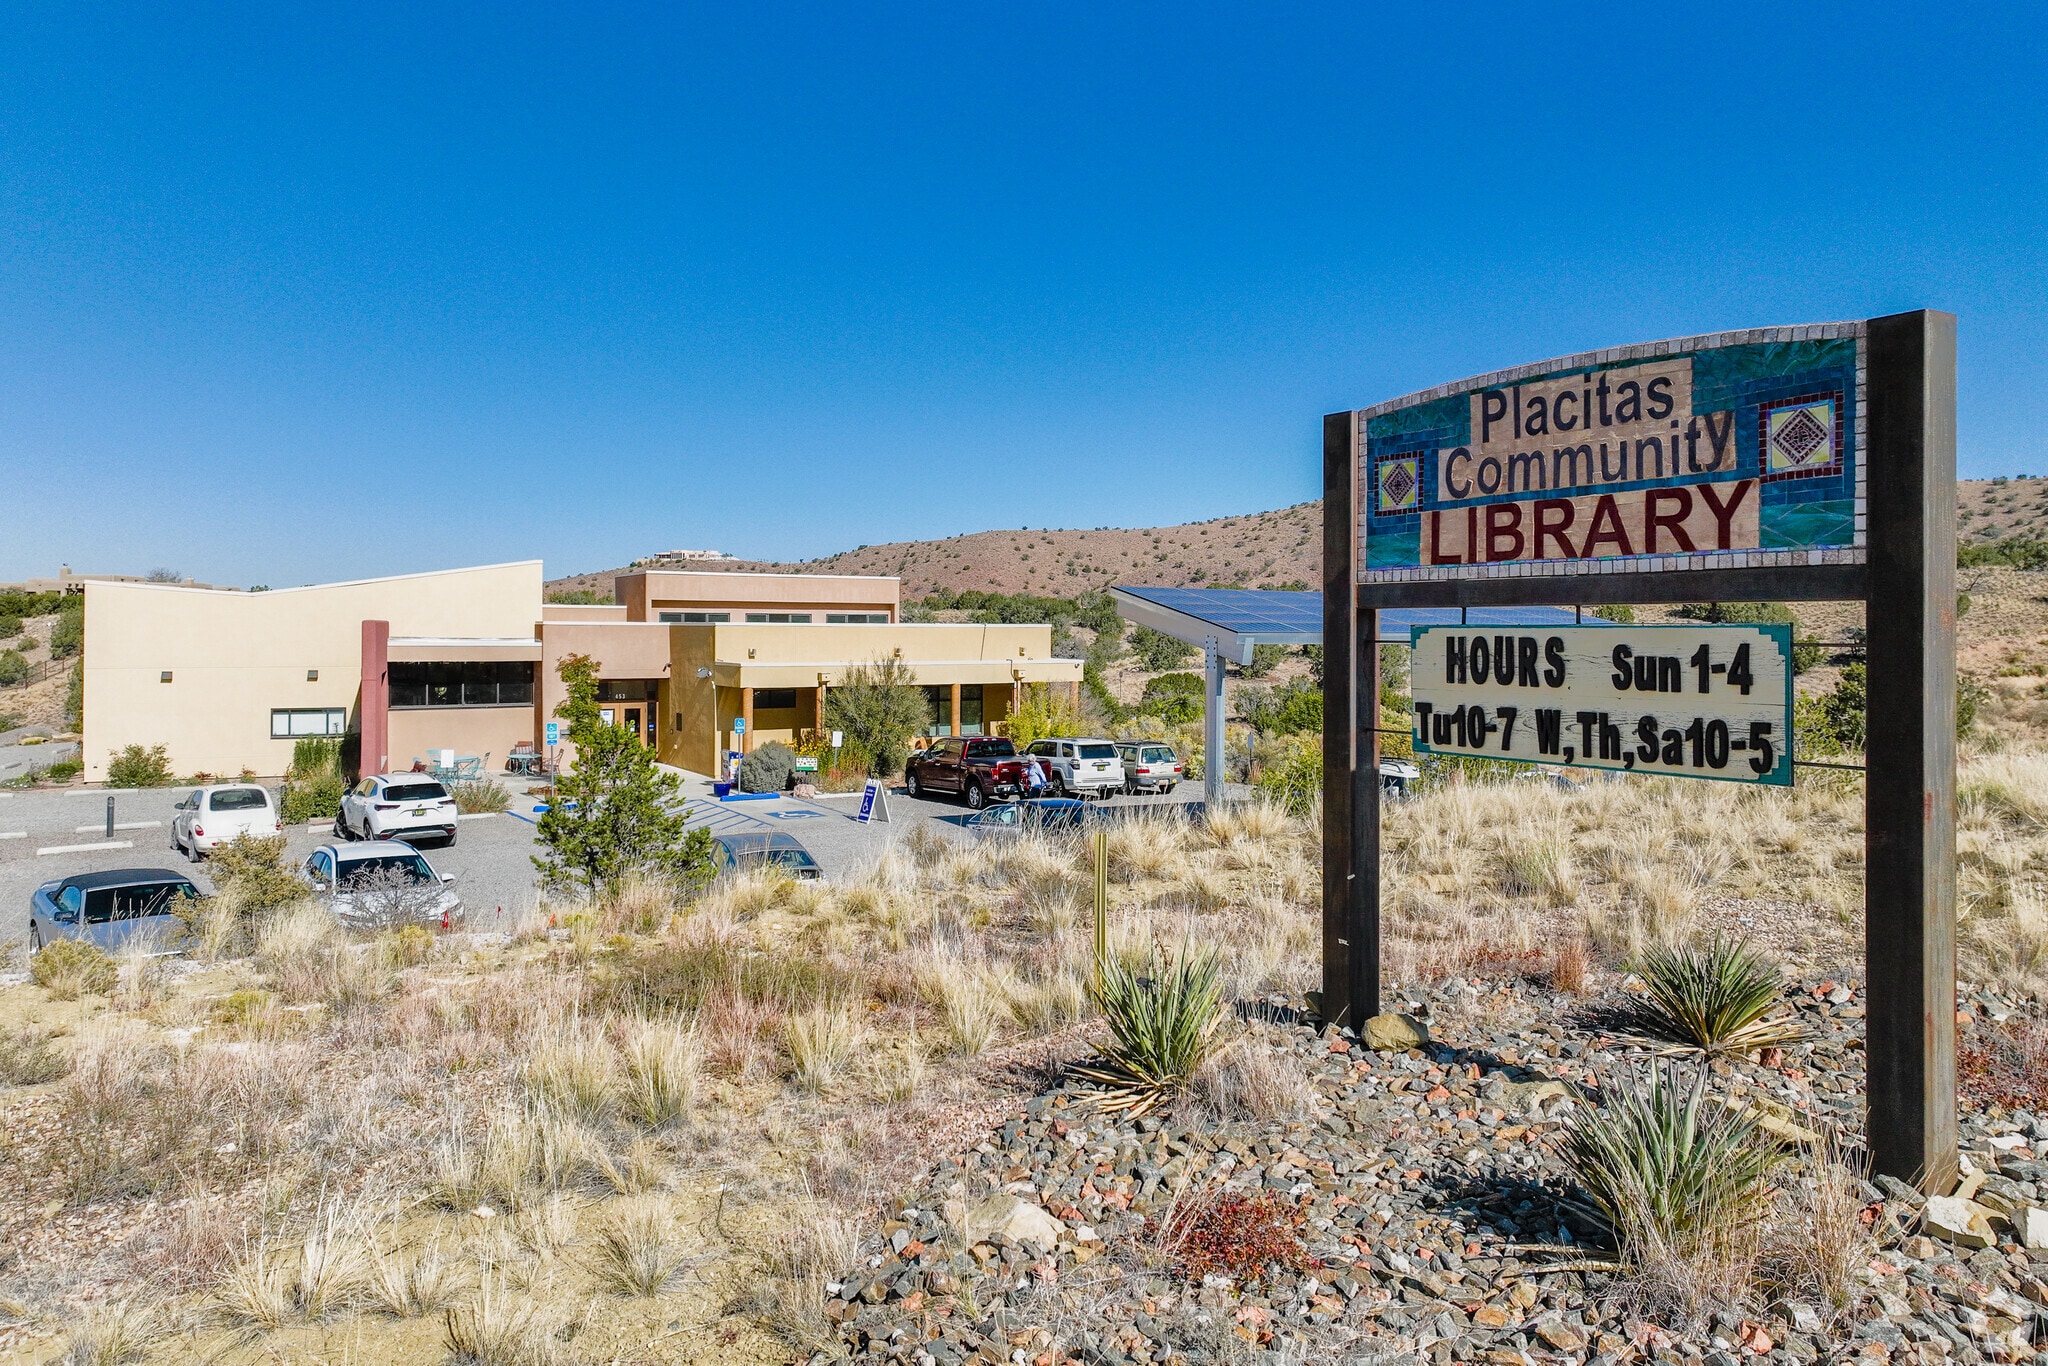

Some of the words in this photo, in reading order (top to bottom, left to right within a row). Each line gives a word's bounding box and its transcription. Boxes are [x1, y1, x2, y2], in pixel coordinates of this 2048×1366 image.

[1481, 373, 1675, 443] Placitas
[1445, 411, 1734, 499] Community
[1431, 480, 1753, 566] LIBRARY
[1445, 636, 1566, 689] HOURS
